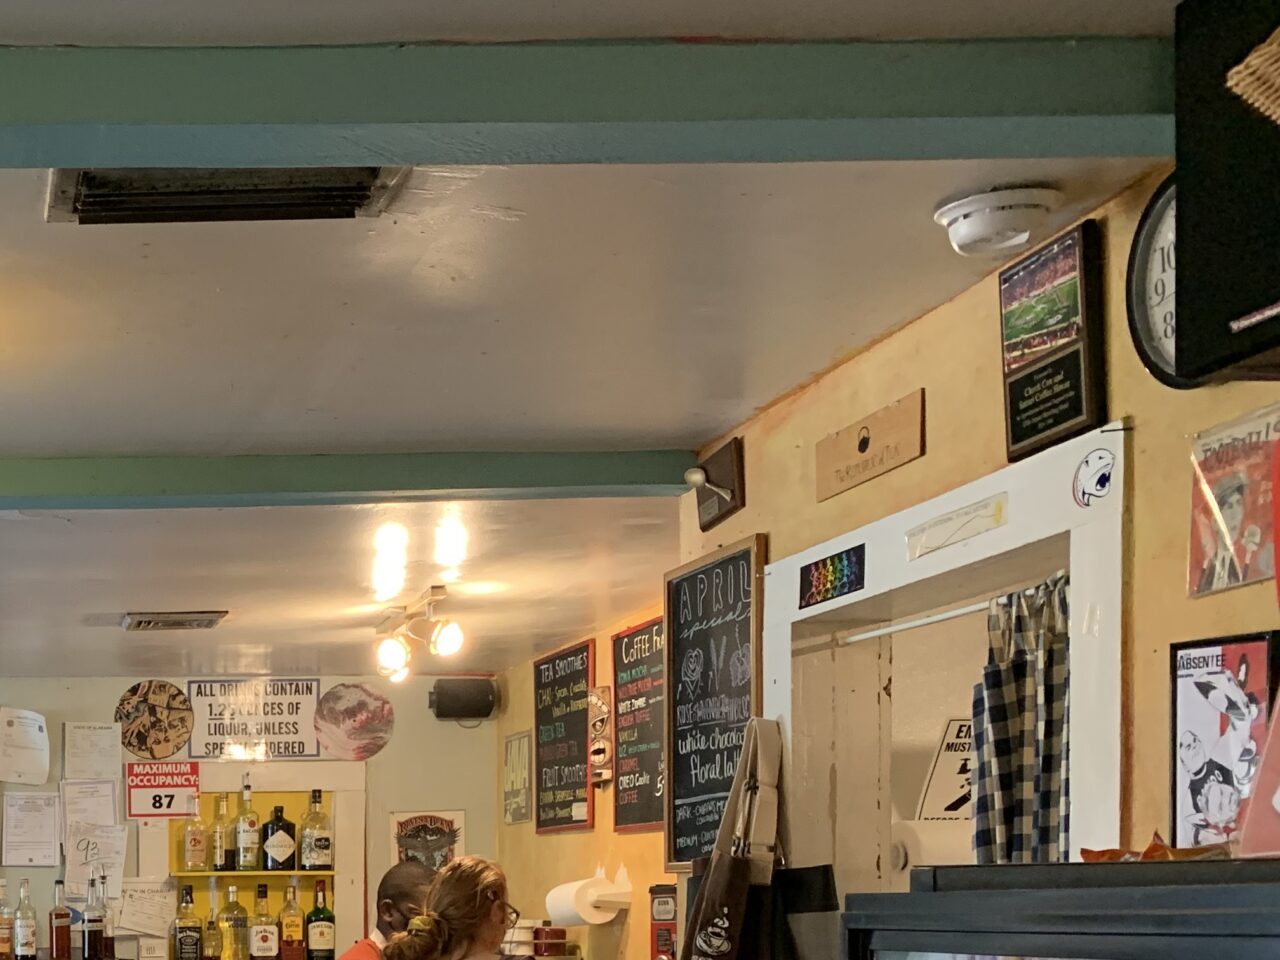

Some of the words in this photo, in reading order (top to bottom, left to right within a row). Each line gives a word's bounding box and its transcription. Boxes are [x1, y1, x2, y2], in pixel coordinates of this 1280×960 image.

[1150, 278, 1166, 309] 9
[1163, 311, 1175, 339] 8
[680, 561, 751, 624] APRIL
[539, 664, 554, 683] TEA
[196, 684, 216, 697] ALL
[220, 683, 262, 697] DRIS
[265, 682, 313, 696] CONTAIN
[287, 702, 301, 716] OF
[256, 721, 299, 735] UNLESS
[255, 741, 305, 755] DERED
[678, 730, 709, 755] white
[944, 742, 972, 752] MUST
[133, 763, 191, 774] MAXIMUM
[690, 753, 723, 788] floral
[128, 775, 199, 787] OCCUPANCY:
[152, 794, 175, 810] 87
